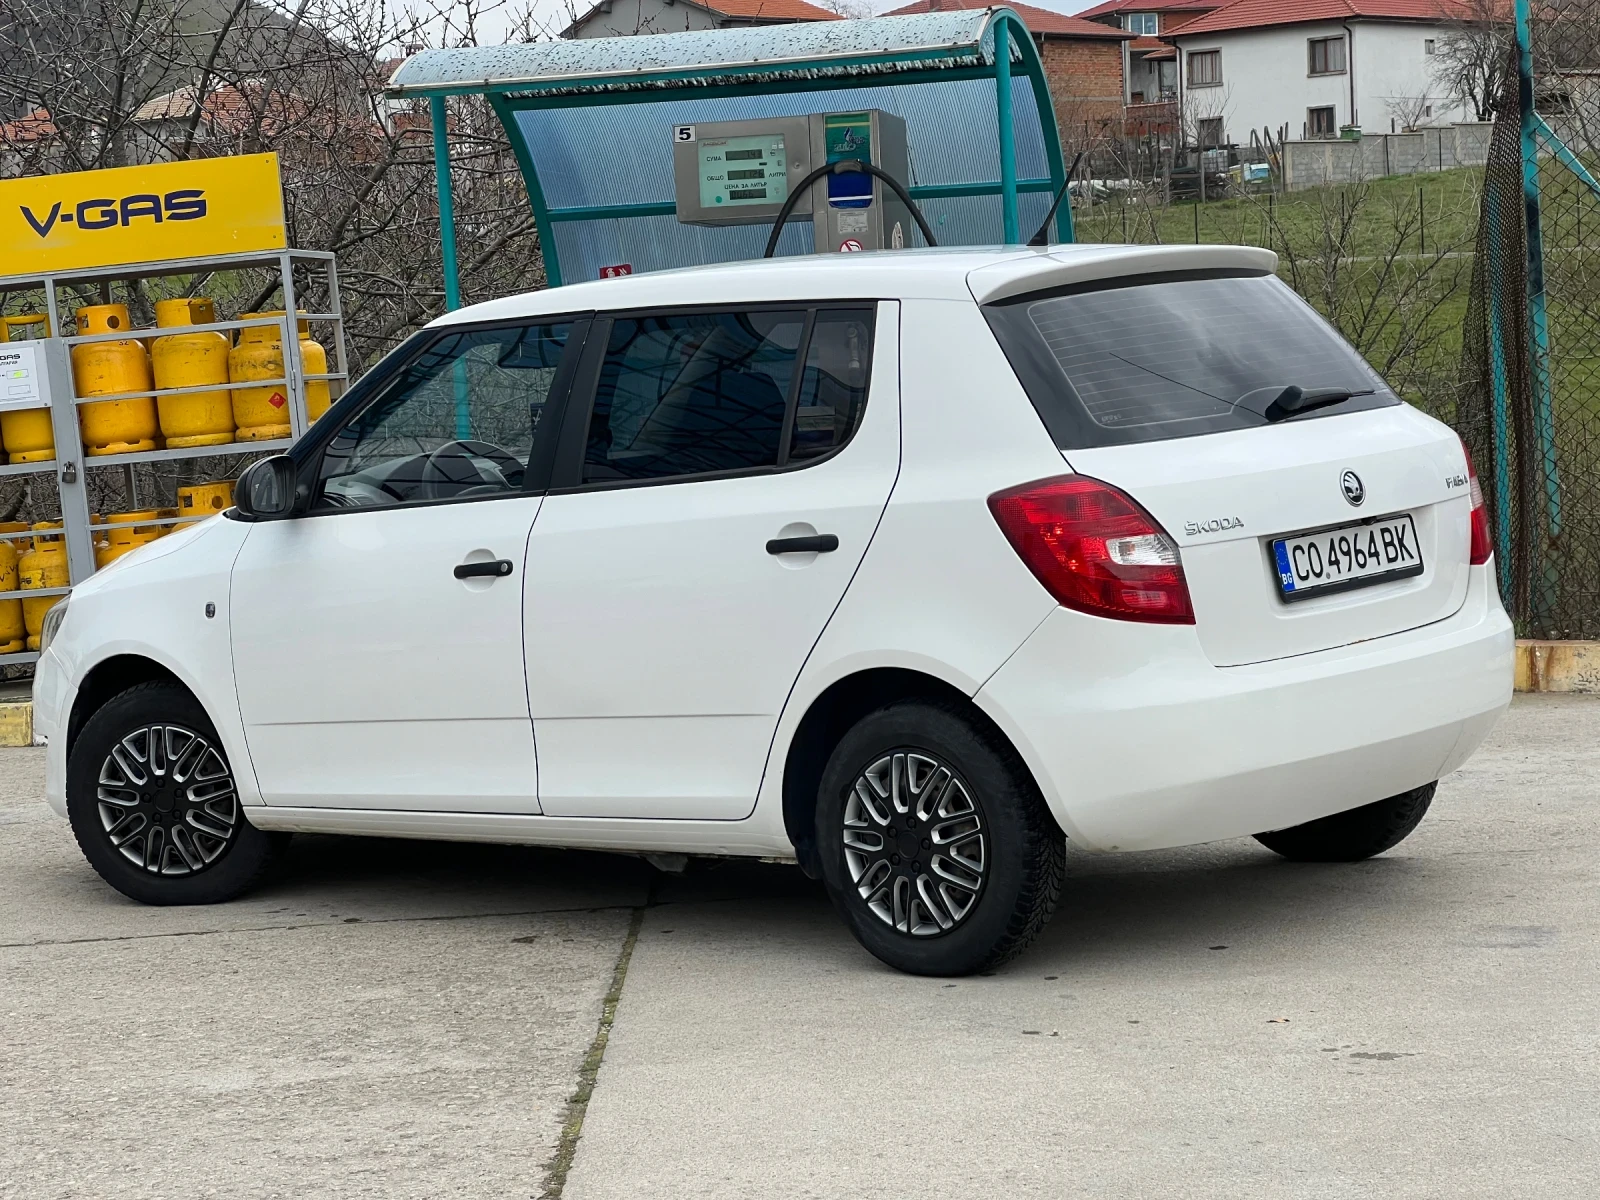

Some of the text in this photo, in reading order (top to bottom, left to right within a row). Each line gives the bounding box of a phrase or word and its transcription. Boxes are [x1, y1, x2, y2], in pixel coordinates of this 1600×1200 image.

[678, 127, 692, 141] 5
[706, 174, 725, 182] ОБЩО
[19, 189, 207, 239] V-GAS
[1281, 572, 1293, 585] BG
